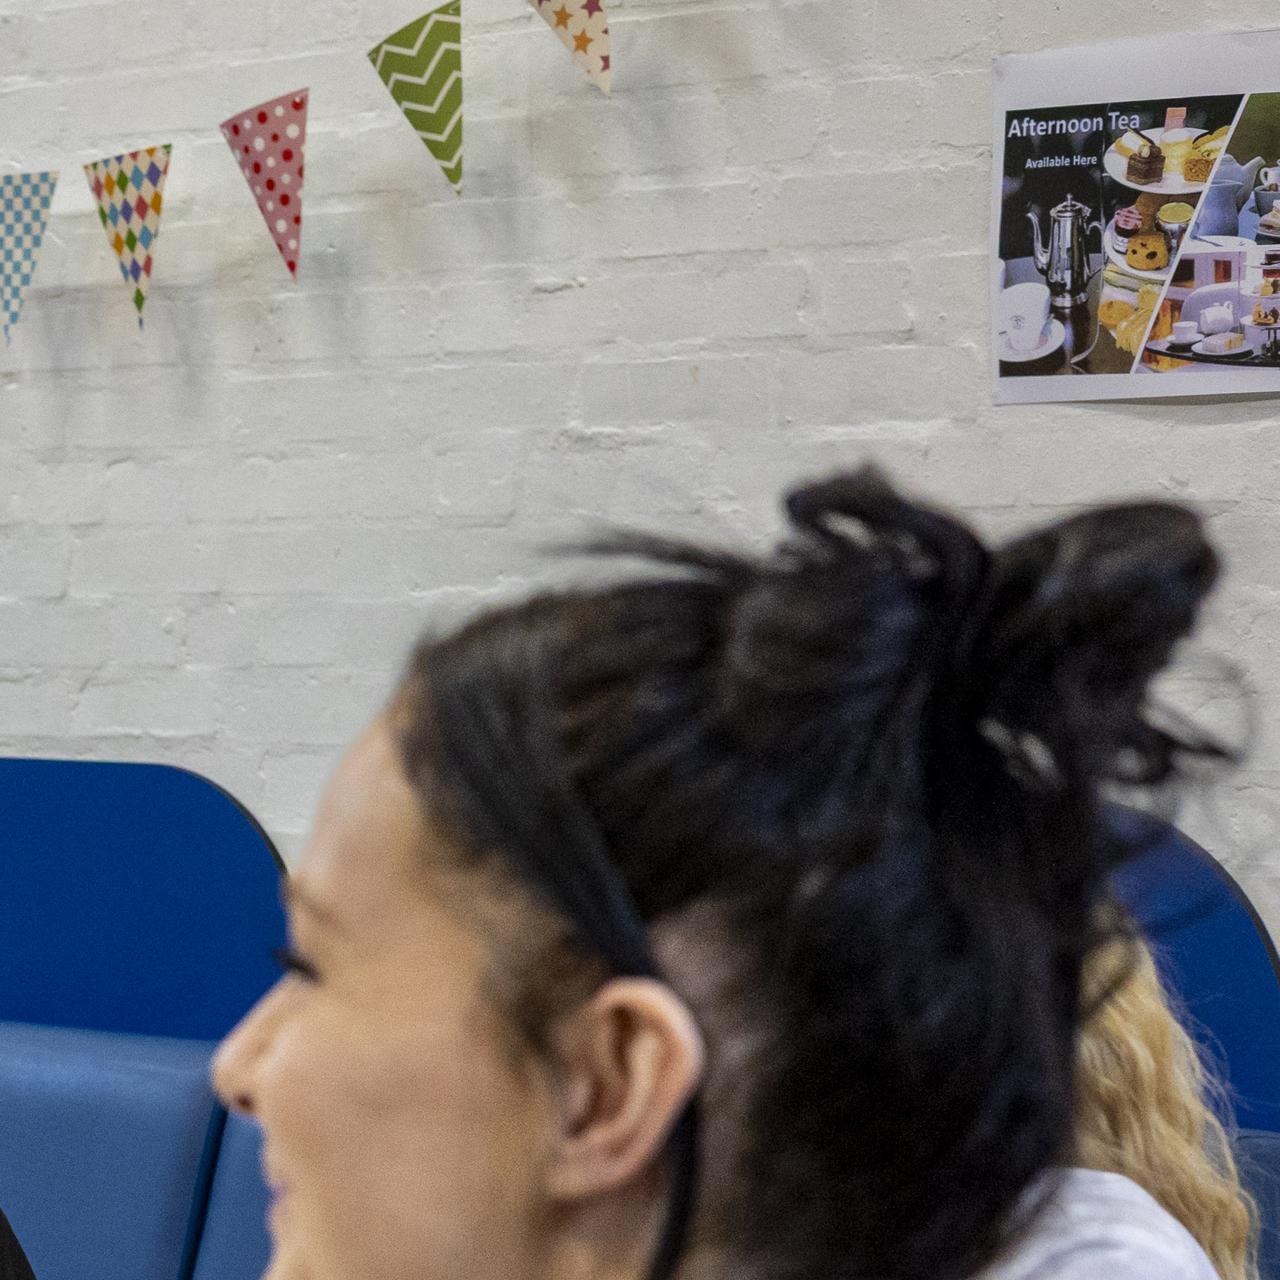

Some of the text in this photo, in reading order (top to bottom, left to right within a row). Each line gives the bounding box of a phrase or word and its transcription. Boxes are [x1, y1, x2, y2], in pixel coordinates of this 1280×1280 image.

[1008, 111, 1141, 138] Afternoon Tea
[1025, 154, 1098, 169] Available Here
